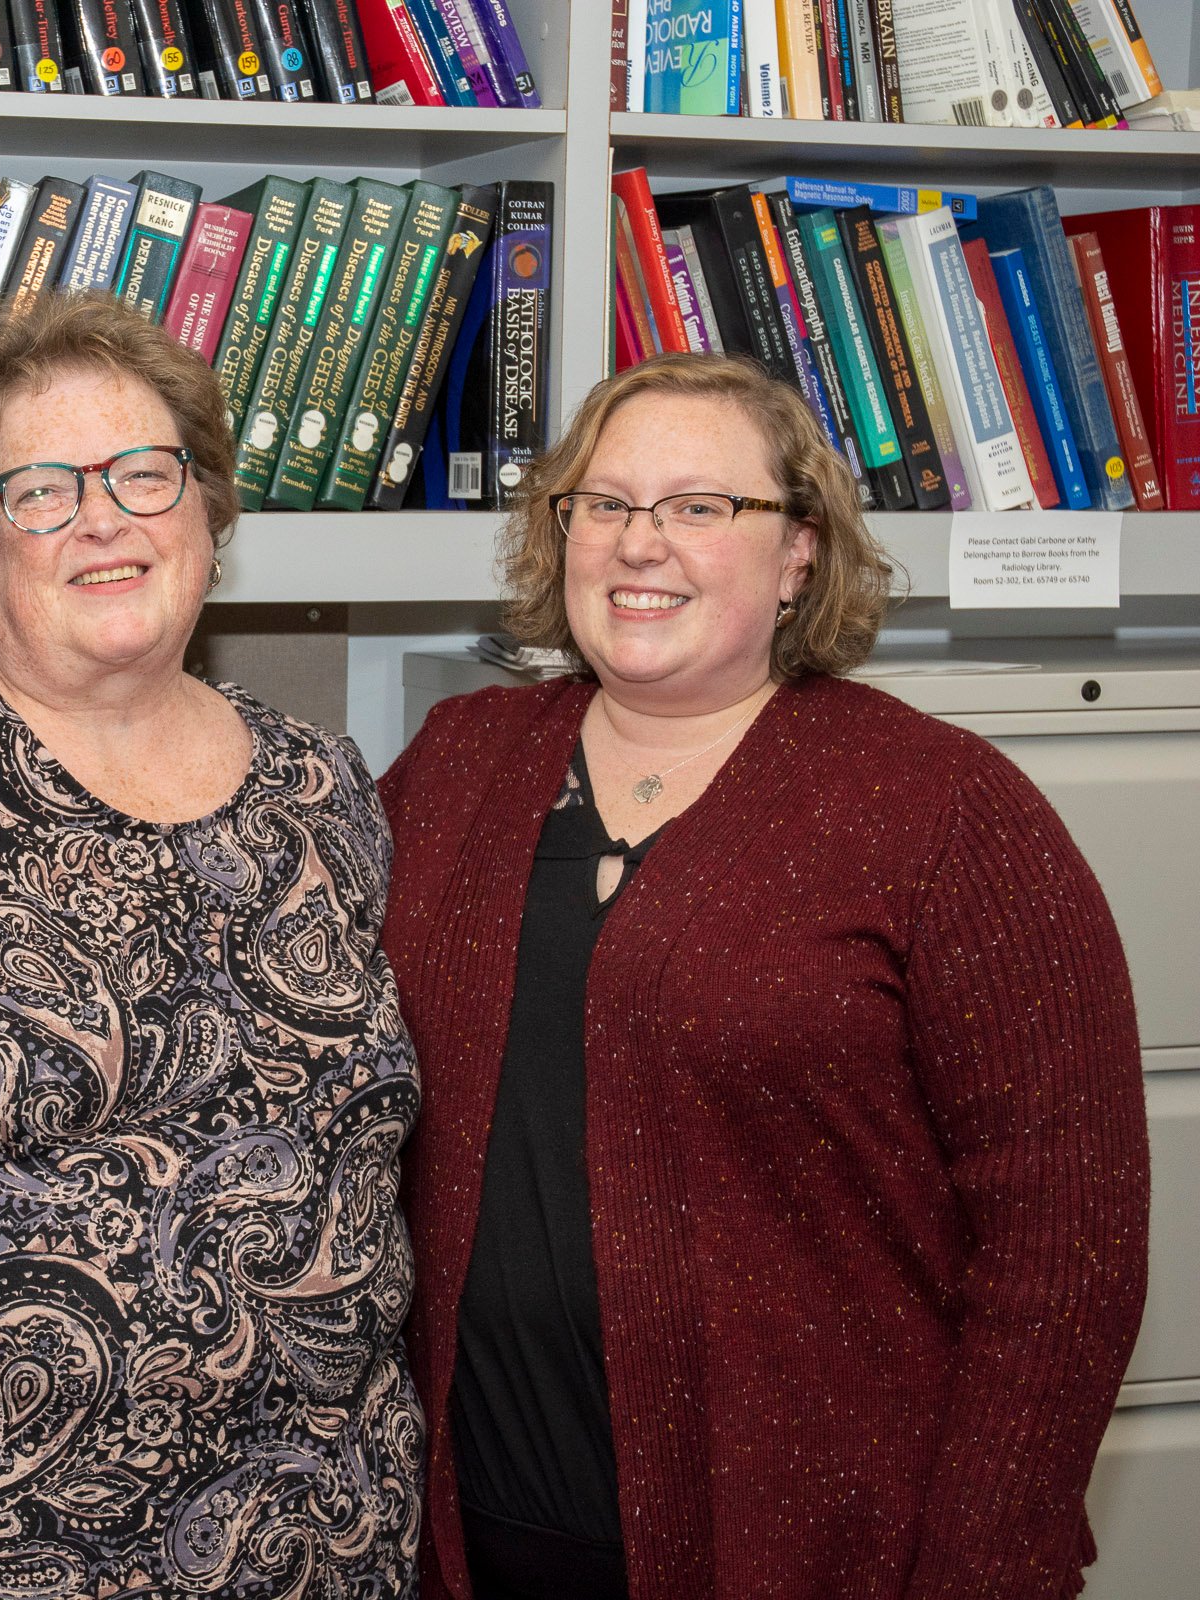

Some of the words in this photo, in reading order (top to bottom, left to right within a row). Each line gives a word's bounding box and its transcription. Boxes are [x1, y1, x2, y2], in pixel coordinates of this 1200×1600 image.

[38, 18, 50, 59] Tirman
[278, 4, 293, 49] Gurney
[731, 15, 739, 47] REVIEW
[802, 13, 814, 55] REVIEW
[877, 0, 895, 58] BRAIN
[39, 65, 54, 75] 125
[106, 53, 121, 66] 60
[164, 52, 179, 65] 155
[241, 57, 257, 69] 159
[287, 51, 299, 66] 88
[759, 63, 772, 106] Volume
[762, 109, 773, 117] 2
[794, 180, 824, 193] Reference
[825, 184, 847, 194] Manual
[847, 186, 857, 194] for
[147, 195, 185, 214] RESNICK
[508, 200, 545, 209] COTRAN
[510, 211, 543, 220] KUMAR
[75, 190, 105, 265] Interventional
[97, 197, 128, 271] Complications
[148, 214, 174, 229] KANG
[507, 223, 545, 231] COLLINS
[643, 205, 661, 243] Journey
[929, 221, 952, 236] LACHMAN
[655, 243, 663, 253] to
[95, 270, 106, 283] in
[288, 237, 320, 302] Diseases
[336, 238, 367, 302] Diseases
[389, 240, 420, 304] Diseases
[655, 253, 678, 307] Authenticity
[428, 267, 451, 314] SURGICAL
[784, 228, 827, 341] Echocardiography
[1093, 270, 1112, 301] Chest
[279, 303, 299, 322] of
[327, 302, 346, 321] of
[379, 305, 398, 324] of
[505, 286, 520, 340] BASIS
[750, 250, 770, 308] RADIOLOGY
[767, 315, 785, 360] LIBRARY
[899, 289, 919, 335] Intensive
[276, 321, 294, 344] the
[324, 321, 341, 343] the
[377, 322, 393, 345] the
[412, 314, 437, 365] ANATOMY
[1097, 302, 1124, 353] Radiology
[503, 342, 518, 361] of
[517, 287, 535, 410] PATHOLOGIC
[832, 257, 859, 335] CARDIOVASCULAR
[853, 335, 872, 380] MAGNETIC
[865, 381, 886, 433] RESONANCE
[910, 334, 925, 360] Care
[1169, 280, 1188, 415] MEDICINE
[233, 325, 266, 396] Diagnosis
[280, 326, 313, 397] Diagnosis
[329, 325, 362, 396] Diagnosis
[380, 327, 413, 398] Diagnosis
[409, 363, 422, 378] OF
[1027, 314, 1041, 346] BREAST
[1035, 346, 1051, 381] IMAGING
[1045, 383, 1064, 431] COMPANION
[256, 346, 288, 412] CHEST
[304, 345, 336, 410] CHEST
[358, 348, 389, 413] CHEST
[403, 377, 418, 397] THE
[916, 360, 937, 406] Medicine
[228, 397, 245, 415] of
[274, 398, 292, 417] of
[320, 397, 338, 416] of
[375, 399, 391, 417] of
[391, 396, 412, 430] JOINTS
[502, 364, 519, 439] DISEASE
[512, 447, 532, 455] Sixth
[988, 446, 1013, 458] EDITION
[991, 441, 1008, 450] FIFTH
[968, 537, 990, 546] Please
[992, 537, 1019, 546] Contact
[1020, 536, 1036, 545] Gabi
[1037, 536, 1066, 545] Carbone
[1076, 536, 1097, 546] Kathy
[963, 550, 1011, 560] Delongchamp
[1021, 550, 1046, 559] Borrow
[1048, 549, 1069, 558] Books
[1070, 549, 1087, 558] from
[1088, 549, 1100, 558] the
[1001, 563, 1035, 573] Radiology
[1036, 562, 1062, 572] Library.
[973, 577, 994, 585] Room
[995, 576, 1021, 586] S2-302,
[1022, 576, 1035, 585] Ext.
[1036, 576, 1058, 584] 65749
[1068, 575, 1090, 583] 65740
